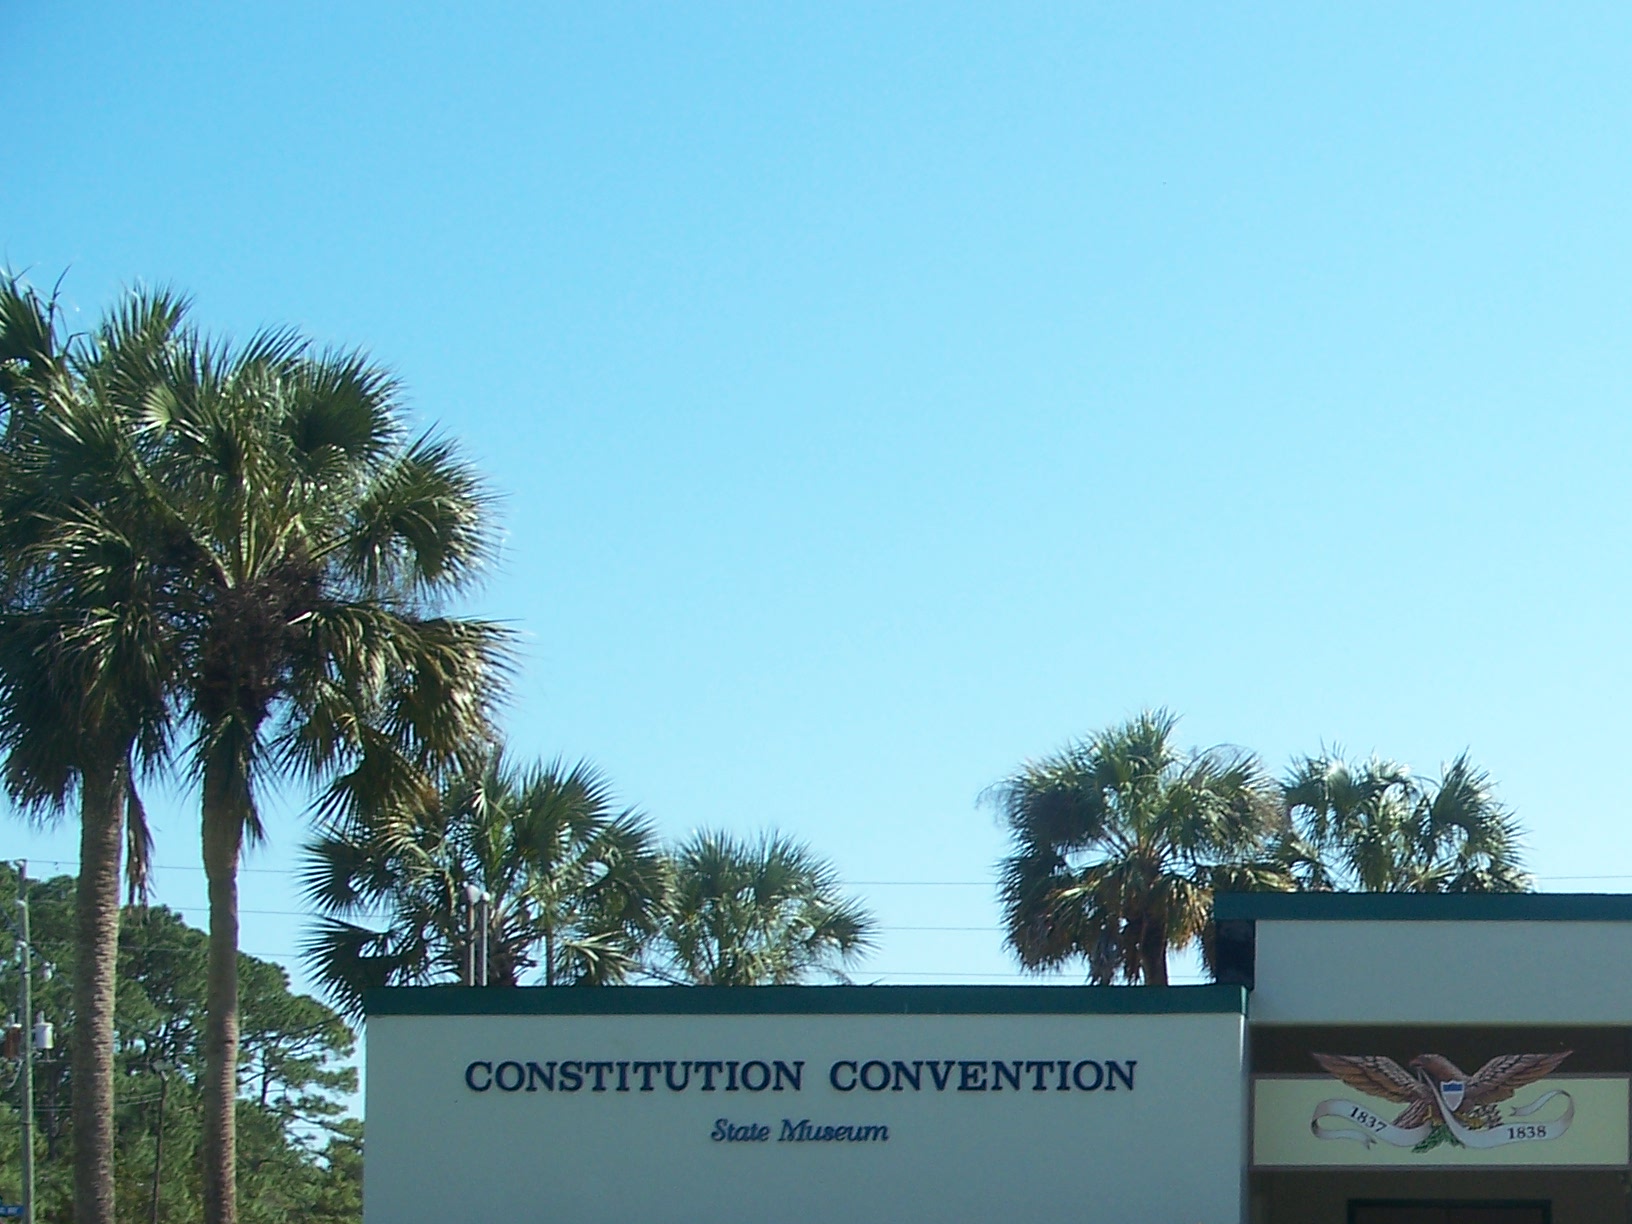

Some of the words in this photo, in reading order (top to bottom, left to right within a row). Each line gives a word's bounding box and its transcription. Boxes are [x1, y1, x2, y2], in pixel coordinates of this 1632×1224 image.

[464, 1060, 805, 1093] CONSTITUTION
[829, 1059, 1139, 1093] CONVENTION
[711, 1118, 770, 1142] State
[778, 1118, 889, 1142] Museum
[1349, 1105, 1387, 1134] 1837
[1507, 1125, 1548, 1140] 1838
